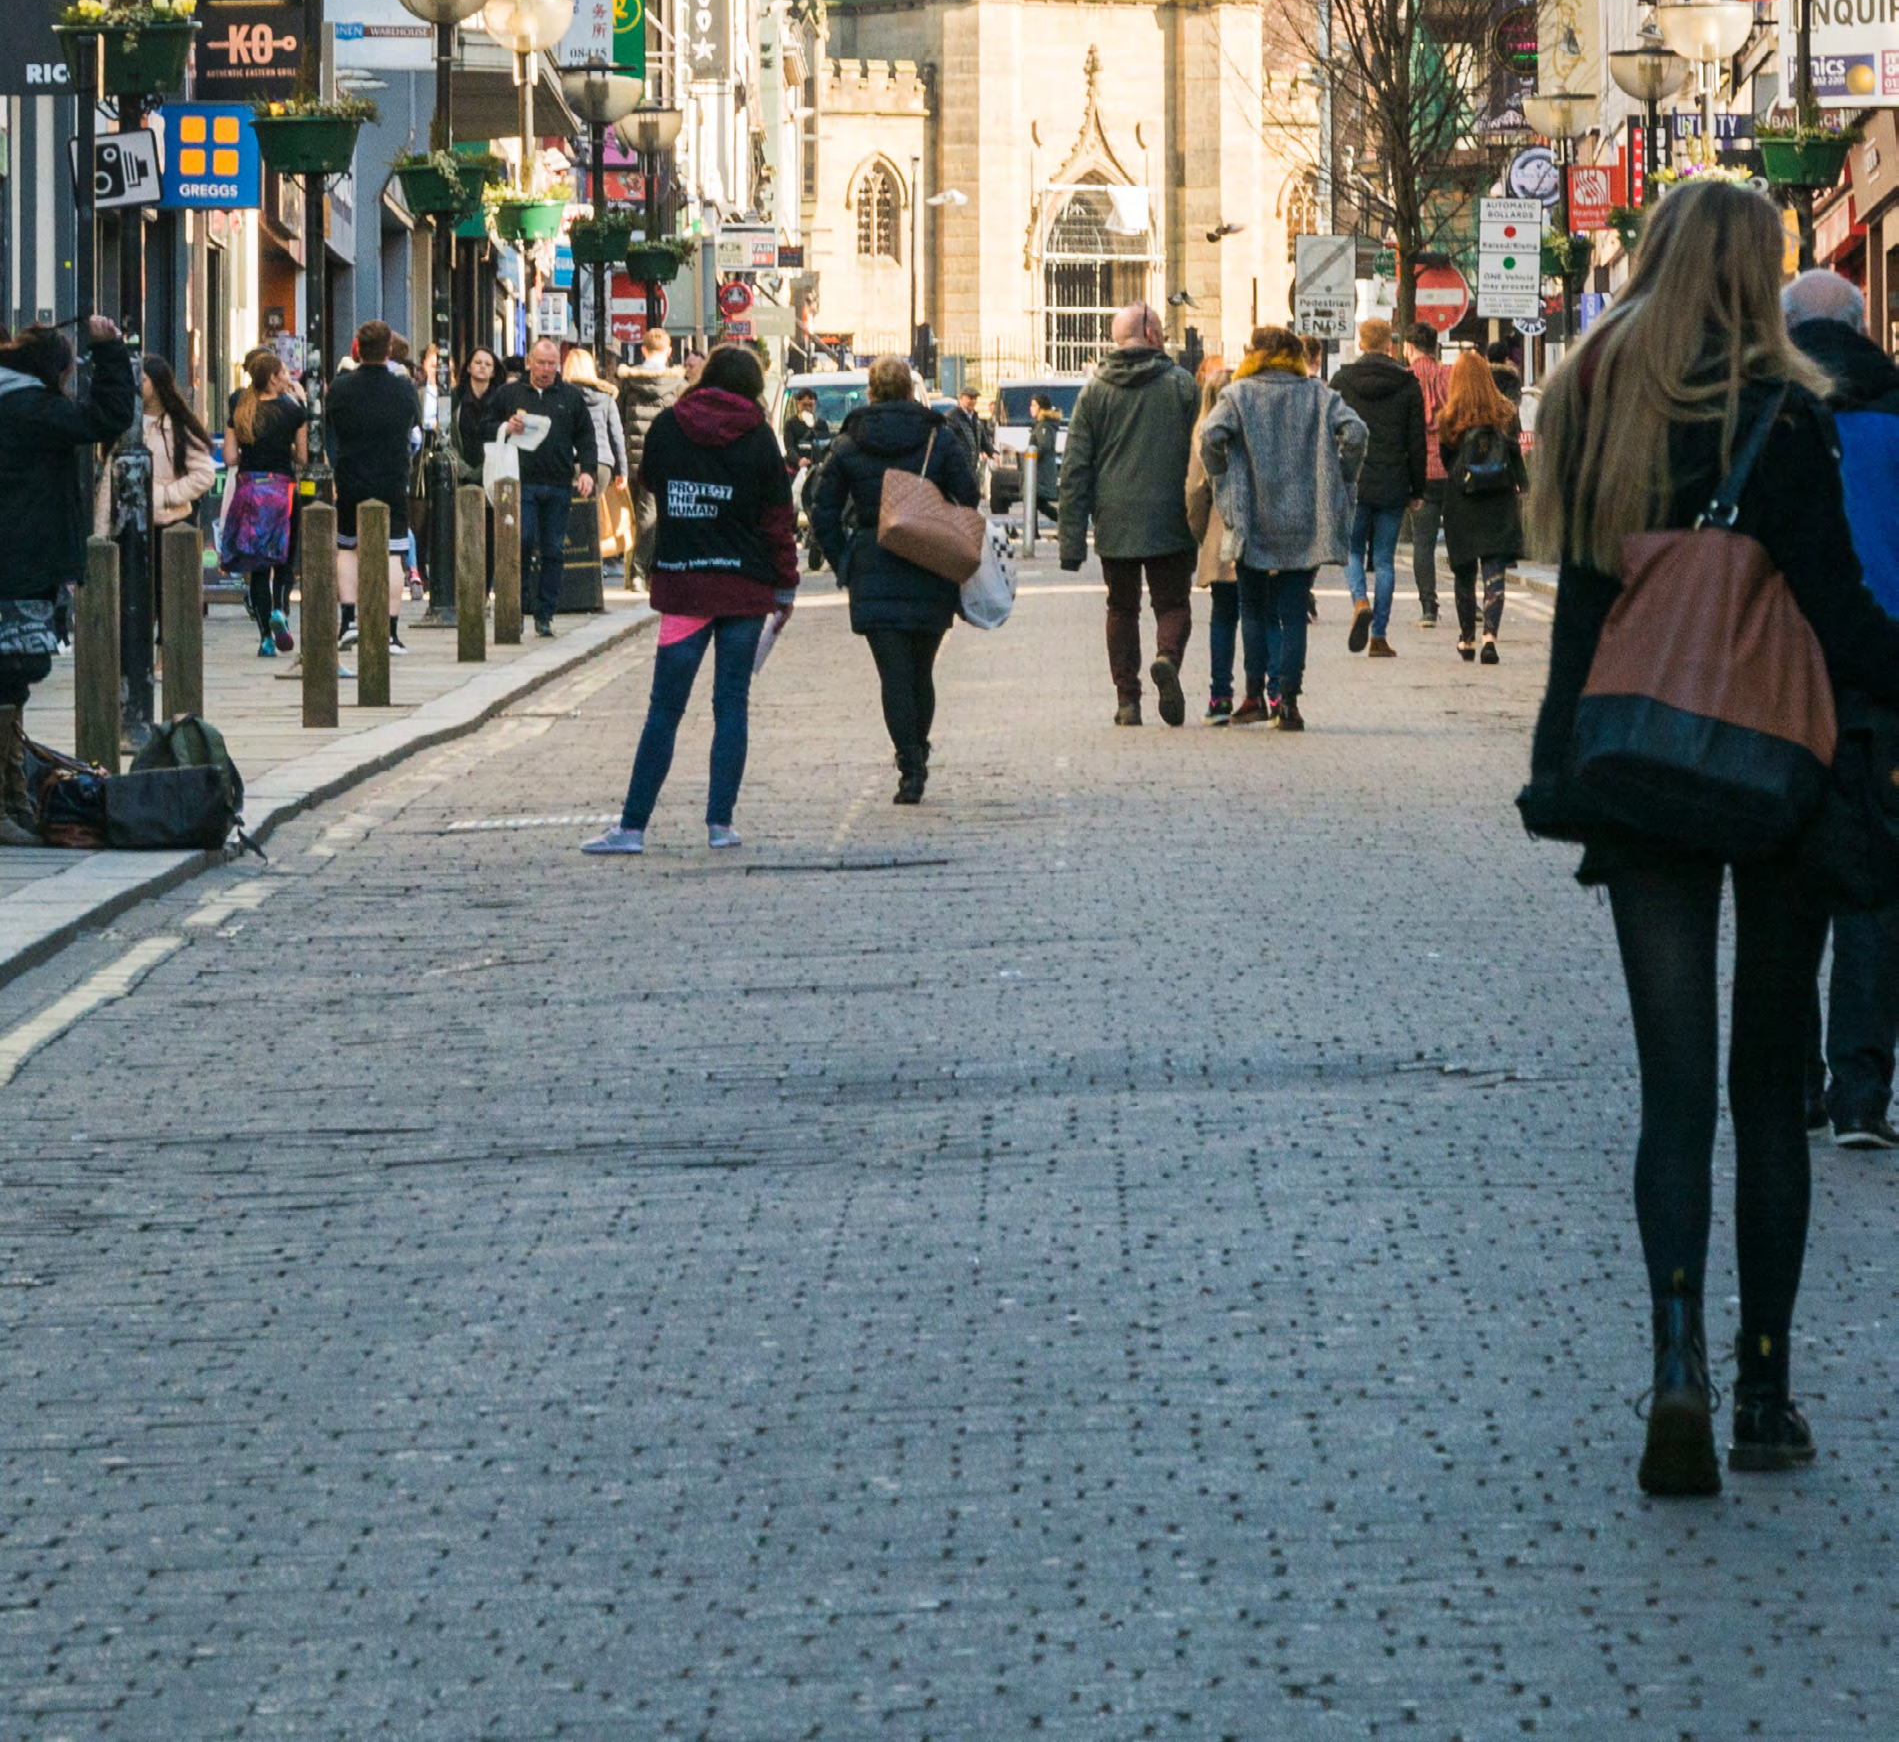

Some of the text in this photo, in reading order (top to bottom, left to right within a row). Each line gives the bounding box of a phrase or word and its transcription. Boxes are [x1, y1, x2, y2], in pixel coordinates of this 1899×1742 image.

[370, 26, 427, 36] WAREHOUSE
[228, 23, 274, 65] KO
[26, 63, 70, 85] RIC
[1677, 114, 1738, 137] UTITY
[179, 183, 239, 197] GREGGS
[1486, 201, 1536, 209] AUTOMATIC
[1487, 211, 1534, 219] BOLLARDS
[1484, 272, 1534, 281] ONE Vehicle
[1501, 283, 1535, 293] proceed
[1300, 298, 1351, 308] Pedestrian
[1302, 319, 1347, 332] ENDS
[668, 481, 732, 499] PROTECT
[668, 493, 695, 505] THE
[668, 504, 718, 516] HUMAN
